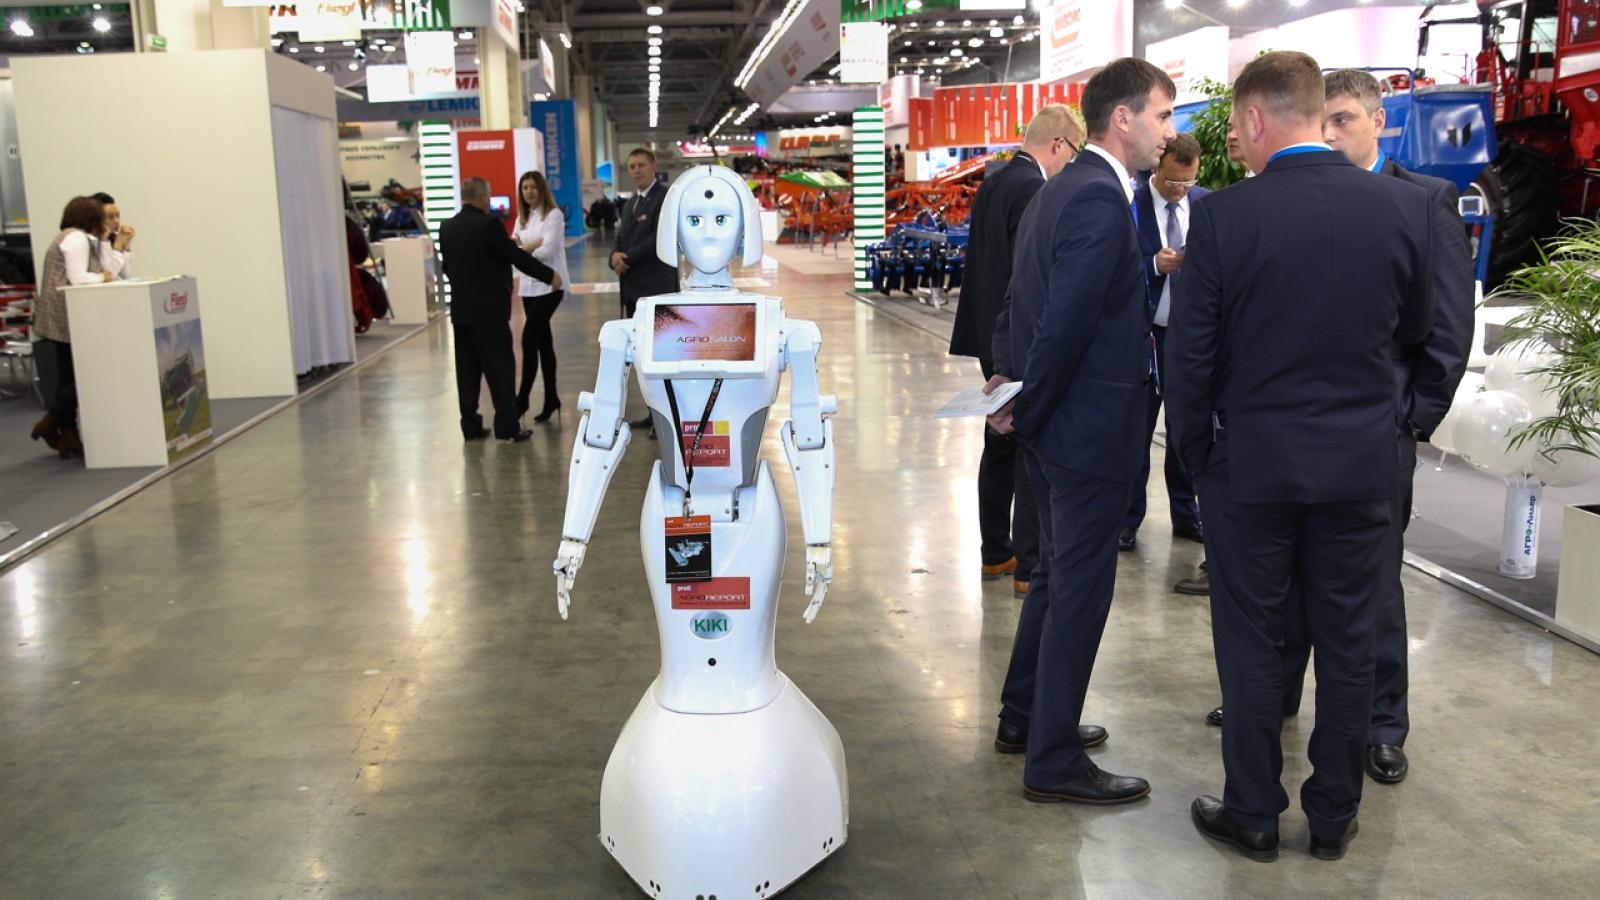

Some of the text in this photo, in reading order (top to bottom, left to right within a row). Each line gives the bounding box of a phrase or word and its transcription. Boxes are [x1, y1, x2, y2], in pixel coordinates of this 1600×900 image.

[428, 96, 480, 112] LEMK
[545, 113, 560, 175] LEMKEN
[694, 618, 728, 632] KIKI
